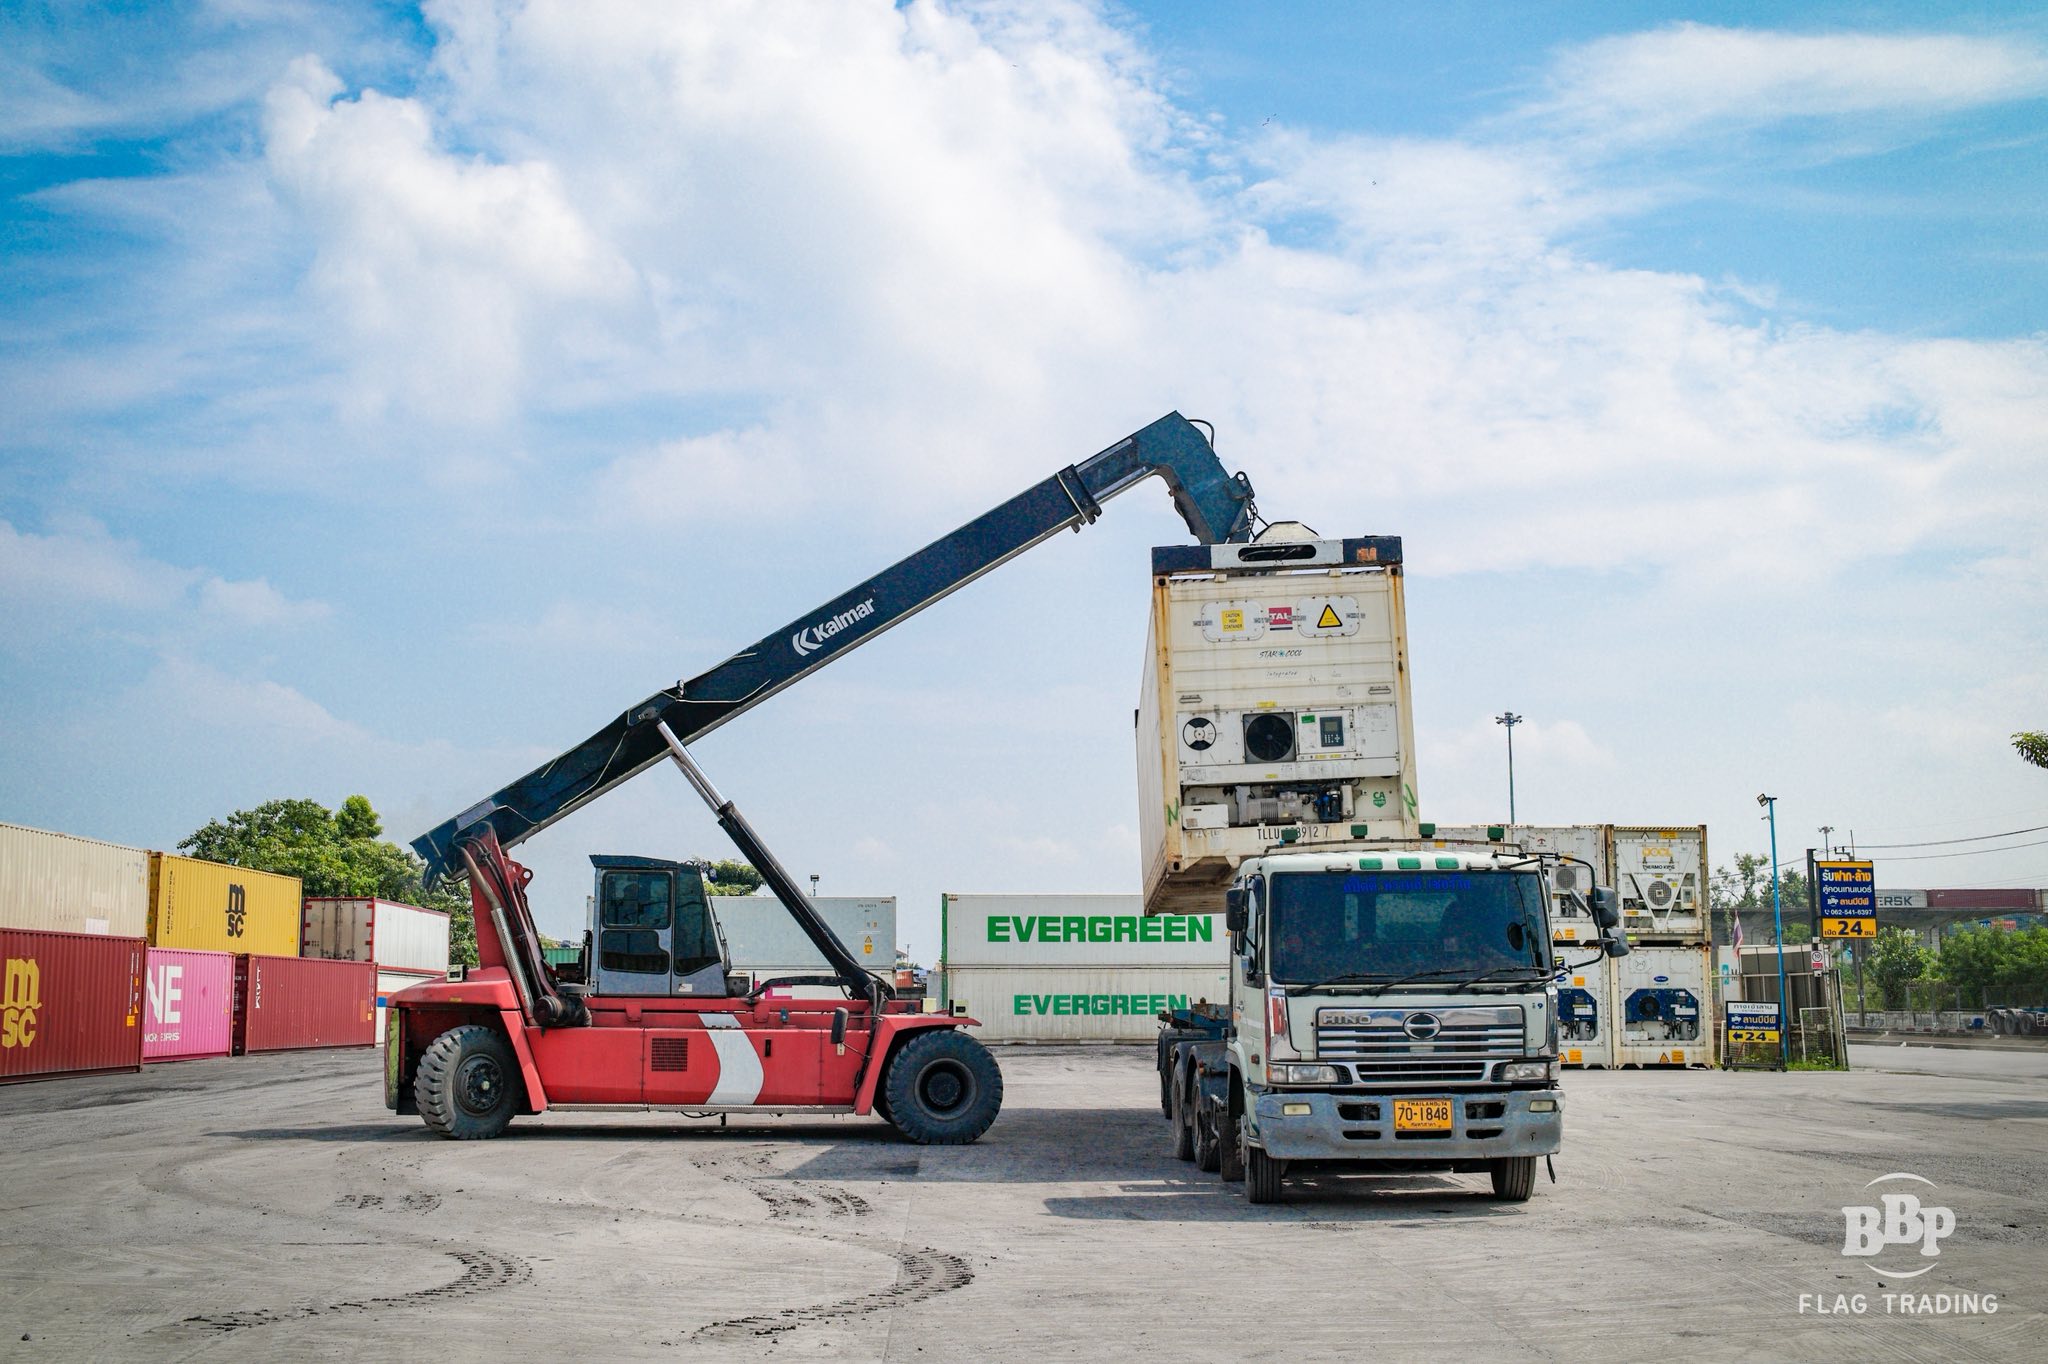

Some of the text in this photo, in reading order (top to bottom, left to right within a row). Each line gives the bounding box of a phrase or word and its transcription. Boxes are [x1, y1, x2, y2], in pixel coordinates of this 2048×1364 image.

[812, 598, 875, 642] Kalmar
[1257, 829, 1280, 840] TLLU
[1877, 896, 1912, 906] ERSK
[987, 916, 1213, 942] EVERGREEN
[1838, 921, 1863, 935] 24
[145, 965, 182, 1024] NE
[1013, 995, 1187, 1015] EVERGREEN
[1323, 1015, 1372, 1024] HINO
[1745, 1032, 1766, 1041] 24
[1398, 1107, 1448, 1121] 70-1848
